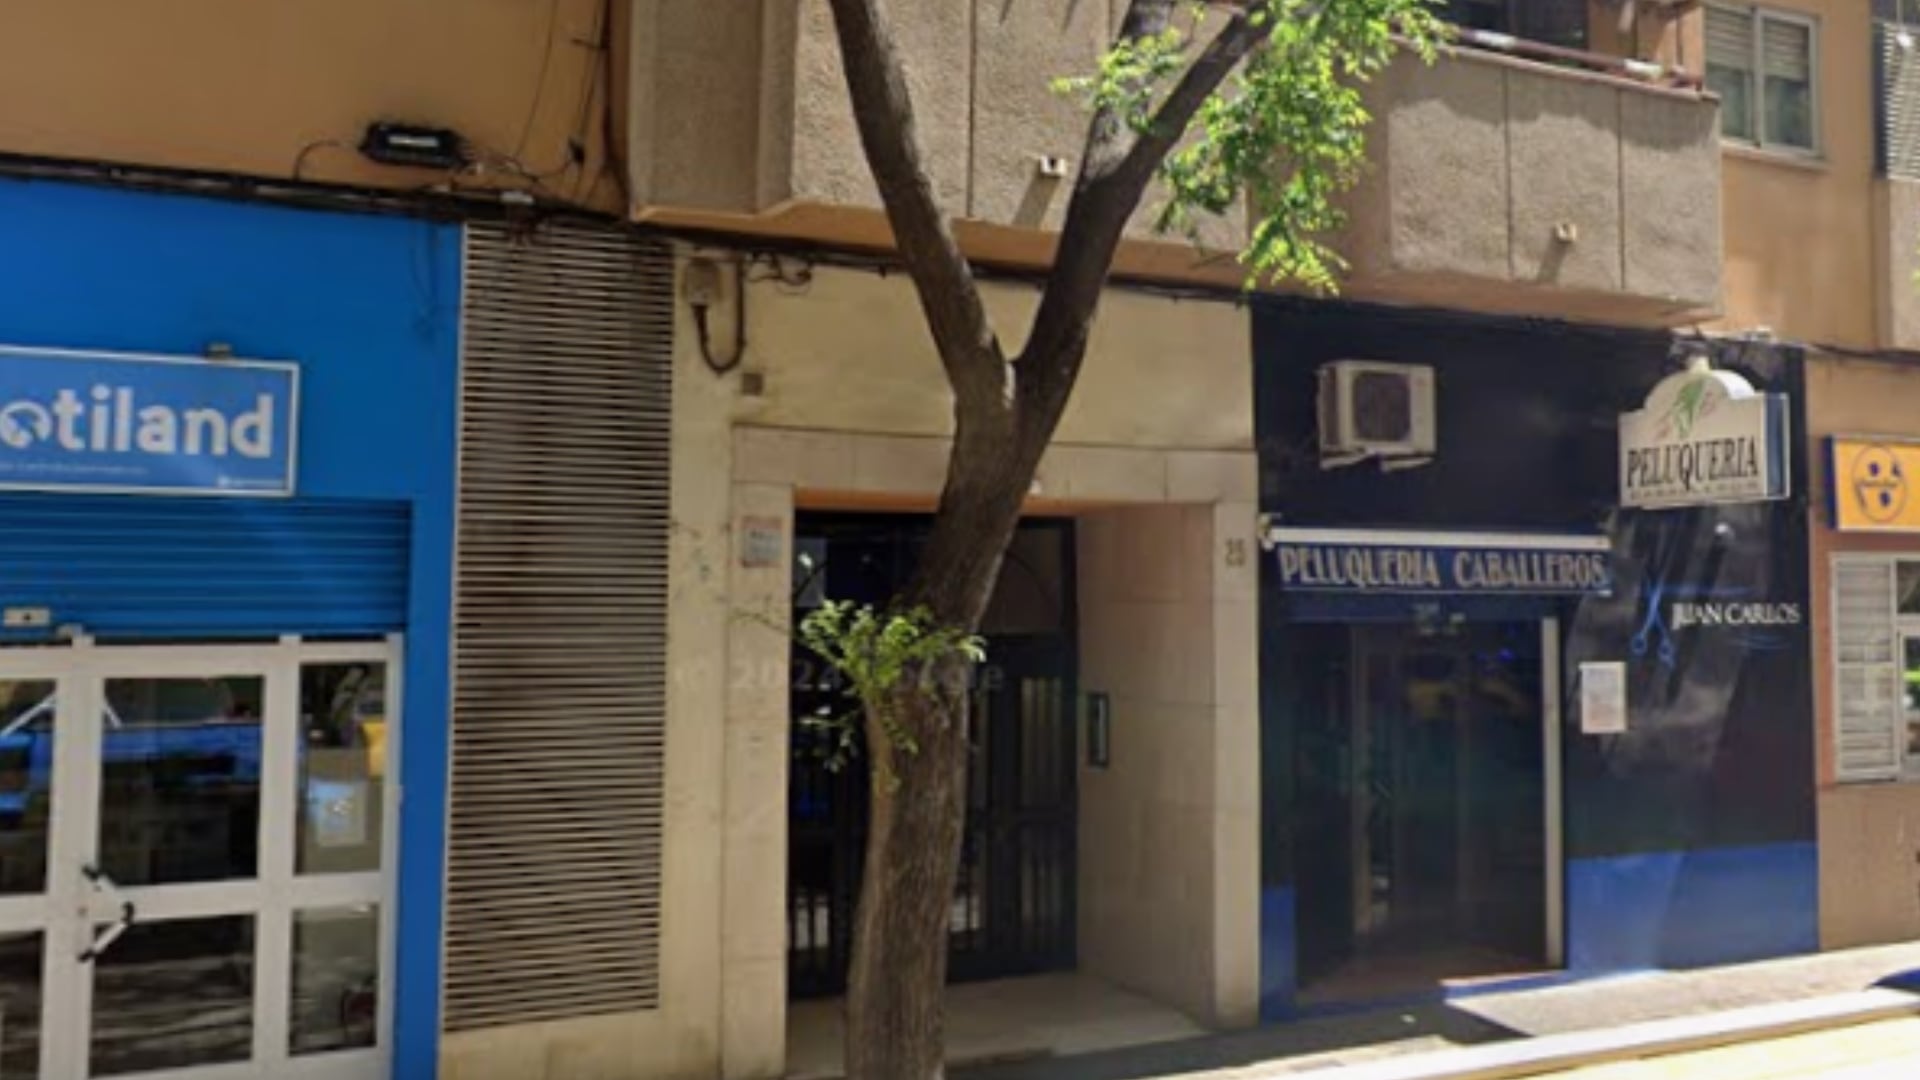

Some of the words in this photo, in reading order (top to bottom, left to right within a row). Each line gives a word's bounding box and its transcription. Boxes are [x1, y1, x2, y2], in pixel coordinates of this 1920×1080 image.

[1626, 434, 1760, 490] PELUQUERIA
[1278, 547, 1440, 588] PELUQUERIA
[1454, 550, 1608, 588] CABALLEROS
[1671, 602, 1723, 631] JUAN
[1724, 602, 1802, 626] CARLOS
